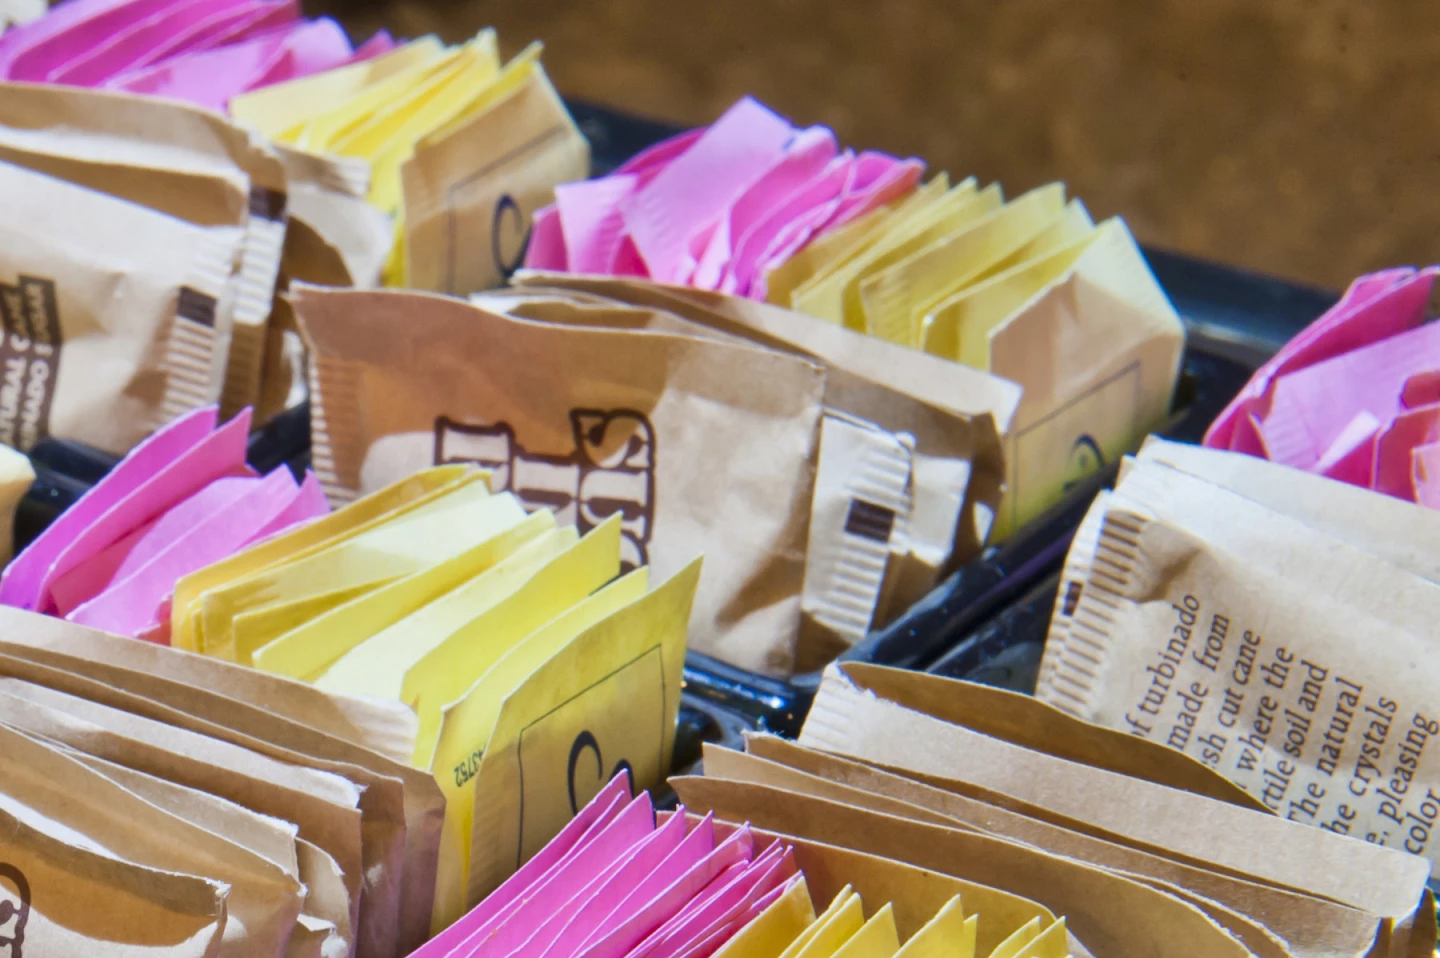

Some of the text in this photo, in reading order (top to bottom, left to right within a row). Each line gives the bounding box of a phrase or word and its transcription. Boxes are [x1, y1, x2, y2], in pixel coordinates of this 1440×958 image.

[1138, 594, 1200, 715] turbinado
[1167, 613, 1230, 750] made from
[1198, 629, 1261, 769] sh cut cane
[1236, 646, 1294, 772] where the
[1262, 660, 1329, 811] rtile soil and
[1316, 676, 1364, 777] natural
[1320, 803, 1357, 835] he
[1348, 696, 1398, 797] crystals
[1375, 711, 1440, 826] pleasing
[1404, 788, 1440, 855] color
